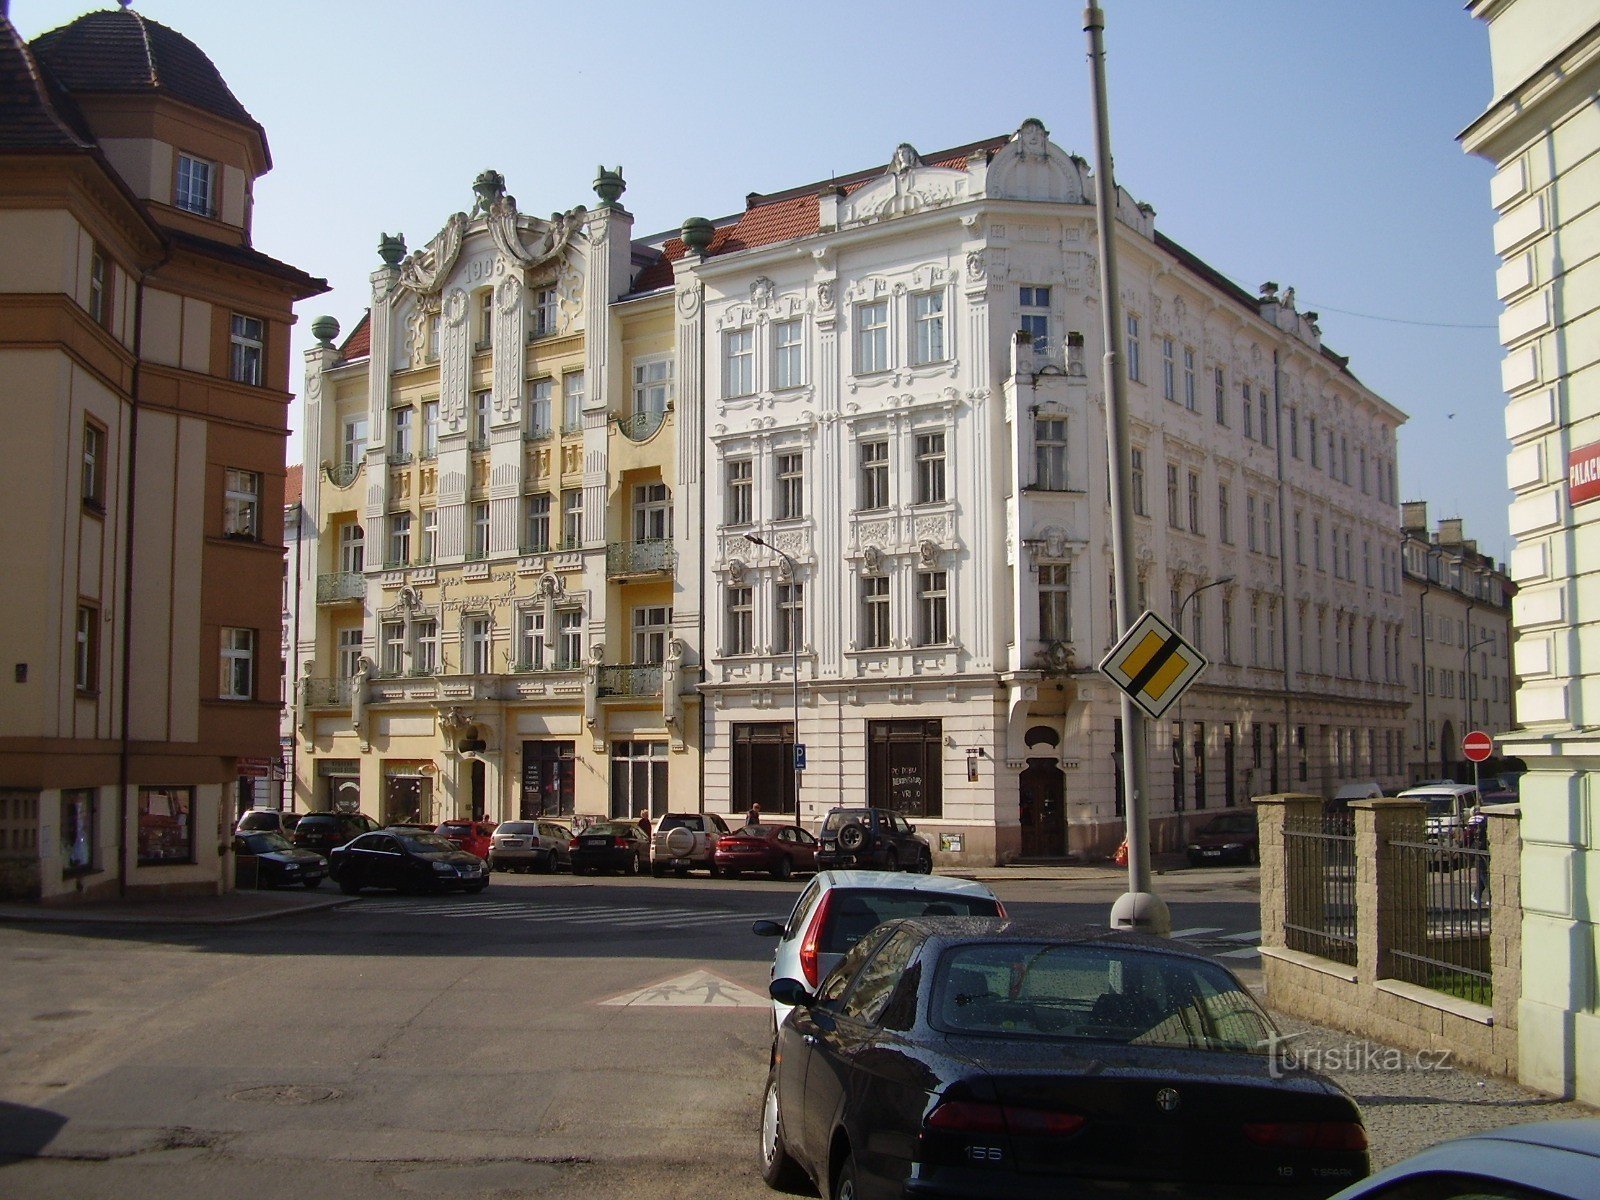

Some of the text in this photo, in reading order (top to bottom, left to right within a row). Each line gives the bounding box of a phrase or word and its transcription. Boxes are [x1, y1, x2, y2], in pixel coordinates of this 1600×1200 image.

[464, 256, 505, 284] 1906
[796, 747, 804, 762] P
[964, 1145, 1002, 1160] 156
